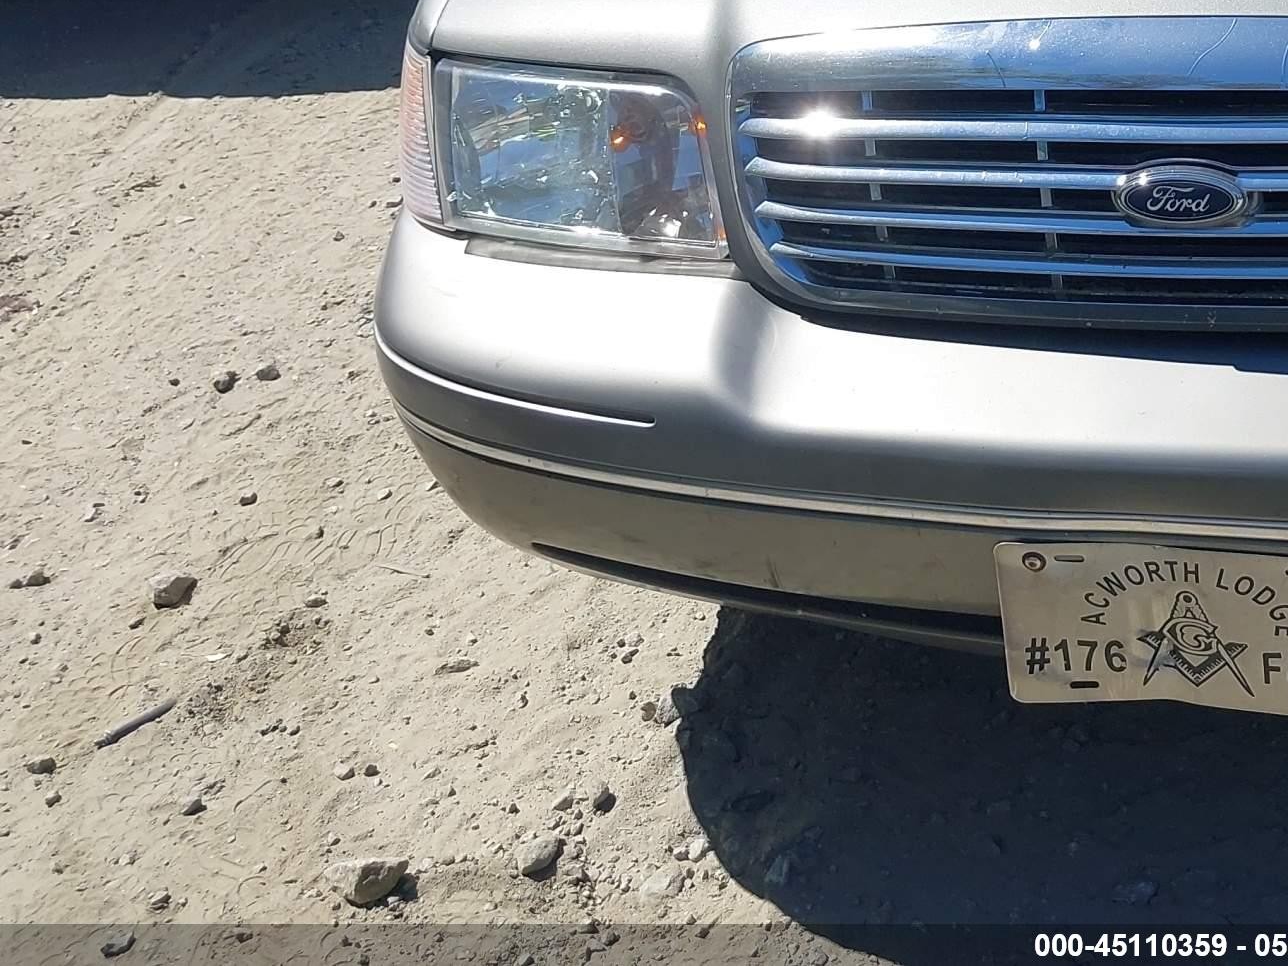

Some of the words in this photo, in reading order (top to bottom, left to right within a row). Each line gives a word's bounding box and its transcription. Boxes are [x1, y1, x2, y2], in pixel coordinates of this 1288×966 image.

[1146, 185, 1211, 212] Ford
[1080, 560, 1199, 626] ACWORTH
[1025, 637, 1128, 675] #176
